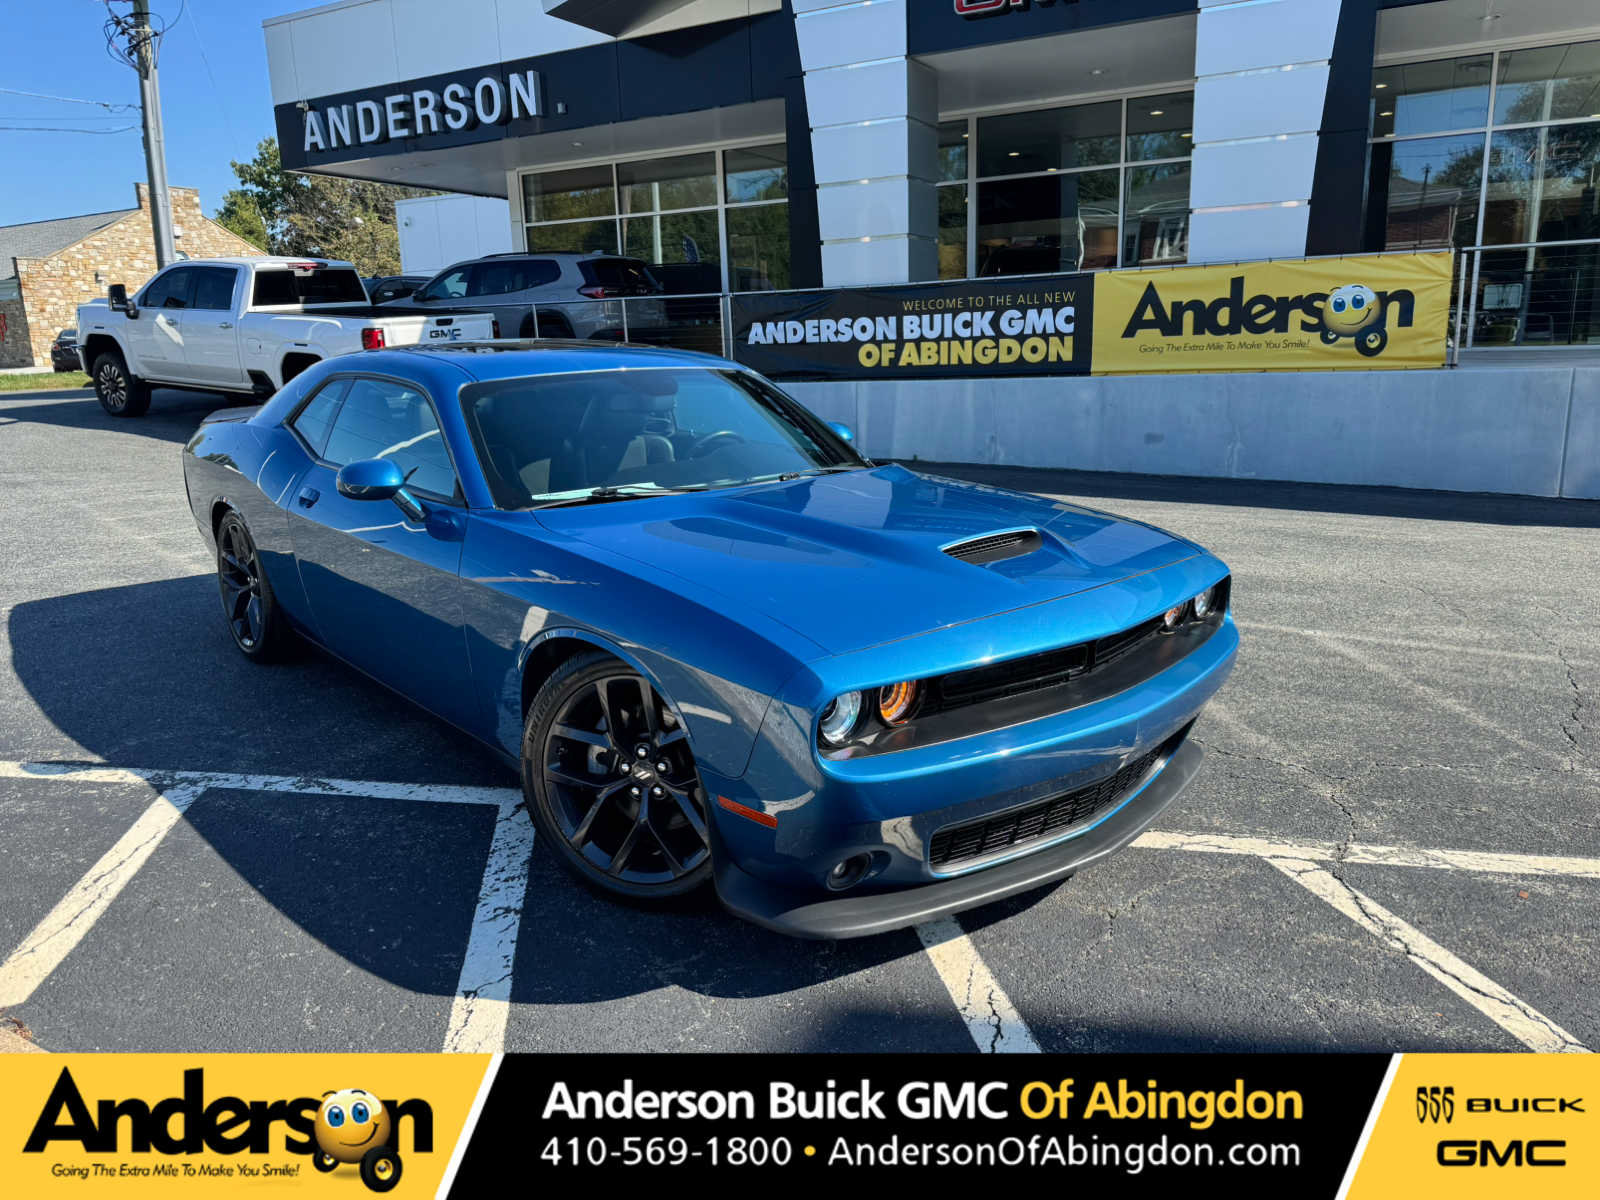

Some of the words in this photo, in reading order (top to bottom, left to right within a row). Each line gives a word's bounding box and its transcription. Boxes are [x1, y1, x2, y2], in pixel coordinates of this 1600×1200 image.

[304, 70, 540, 152] ANDERSON
[903, 297, 963, 311] WELCOME
[967, 296, 985, 308] TO
[988, 294, 1013, 307] THE
[1016, 293, 1040, 305] ALL
[1044, 290, 1076, 304] NEW
[1121, 276, 1415, 338] Andersn
[429, 328, 462, 339] GMC
[748, 316, 897, 345] ANDERSON
[902, 310, 996, 340] BUICK
[999, 306, 1075, 336] GMC
[858, 343, 896, 368] OF
[898, 335, 1074, 367] ABINGDON
[1138, 343, 1164, 354] Going
[1166, 343, 1182, 352] The
[1183, 342, 1205, 352] Extra
[1205, 341, 1225, 351] Mile
[1226, 341, 1236, 350] To
[1238, 340, 1262, 350] Make
[1264, 339, 1281, 349] You
[1282, 338, 1311, 349] Smile!
